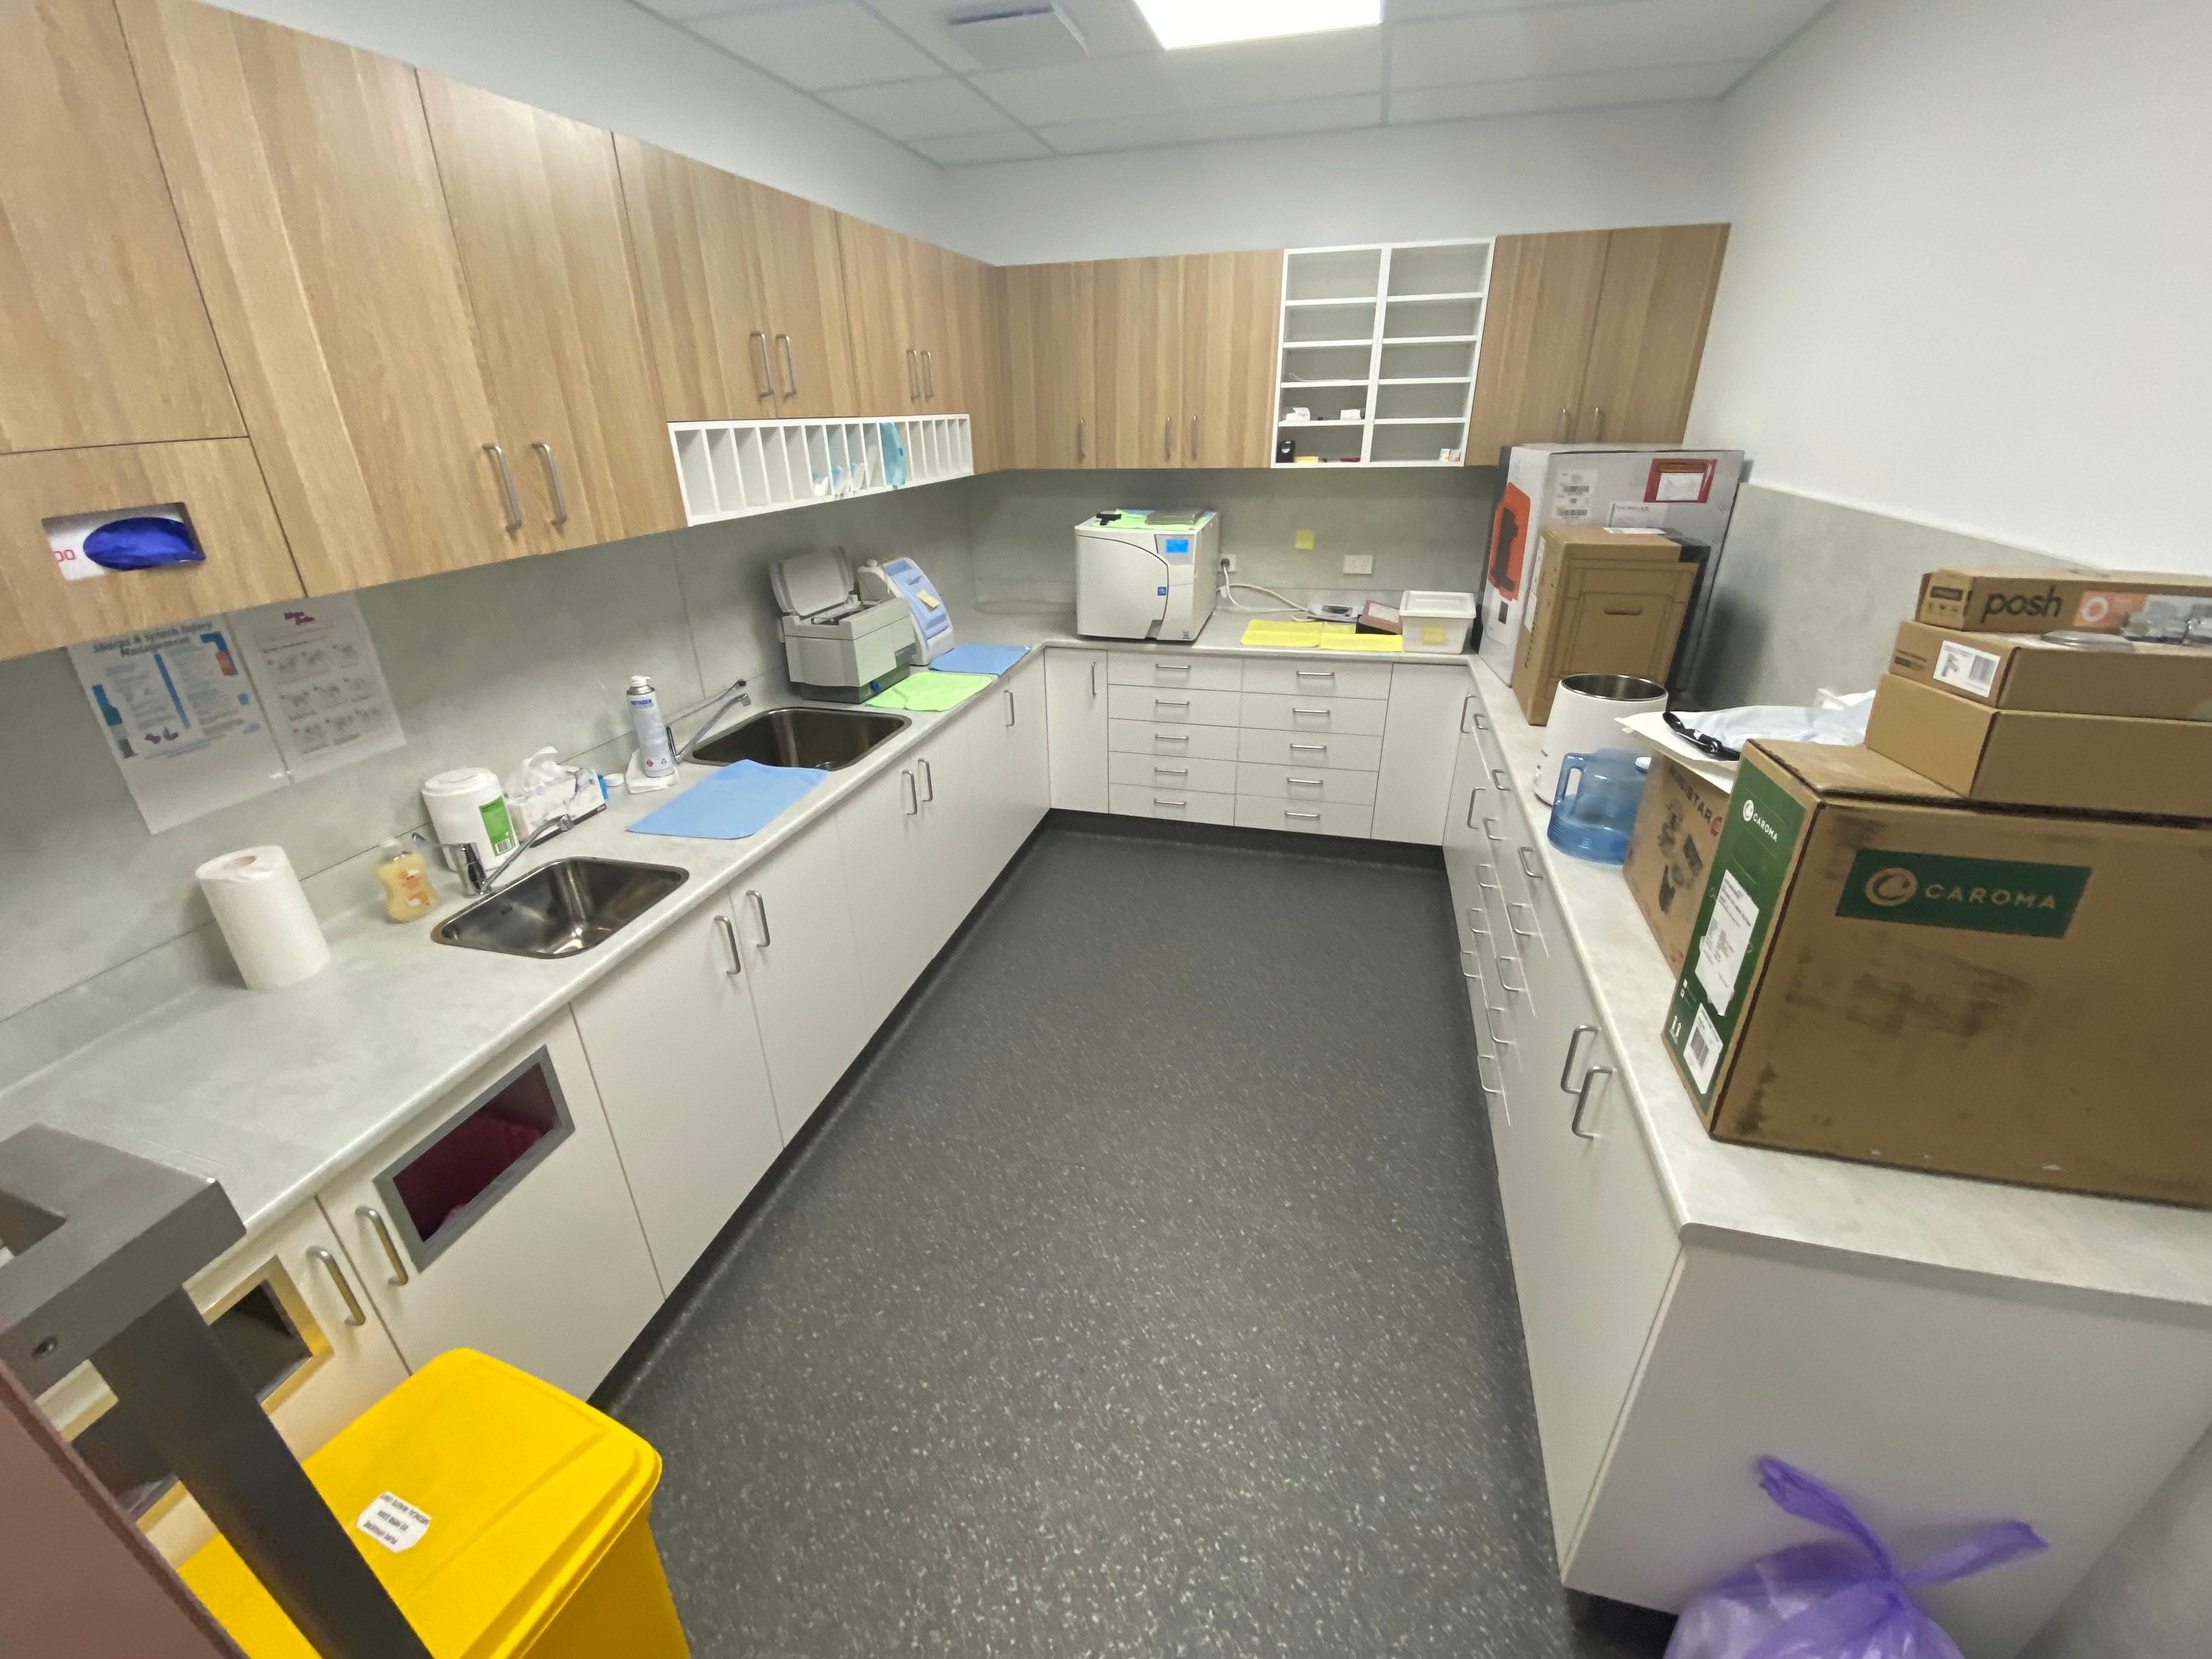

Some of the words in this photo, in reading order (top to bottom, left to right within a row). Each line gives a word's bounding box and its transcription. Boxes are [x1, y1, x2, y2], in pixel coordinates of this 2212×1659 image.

[1979, 584, 2063, 624] posh
[122, 636, 189, 657] Management
[1753, 813, 1778, 842] CAROMA
[1925, 883, 2056, 910] CAROMA
